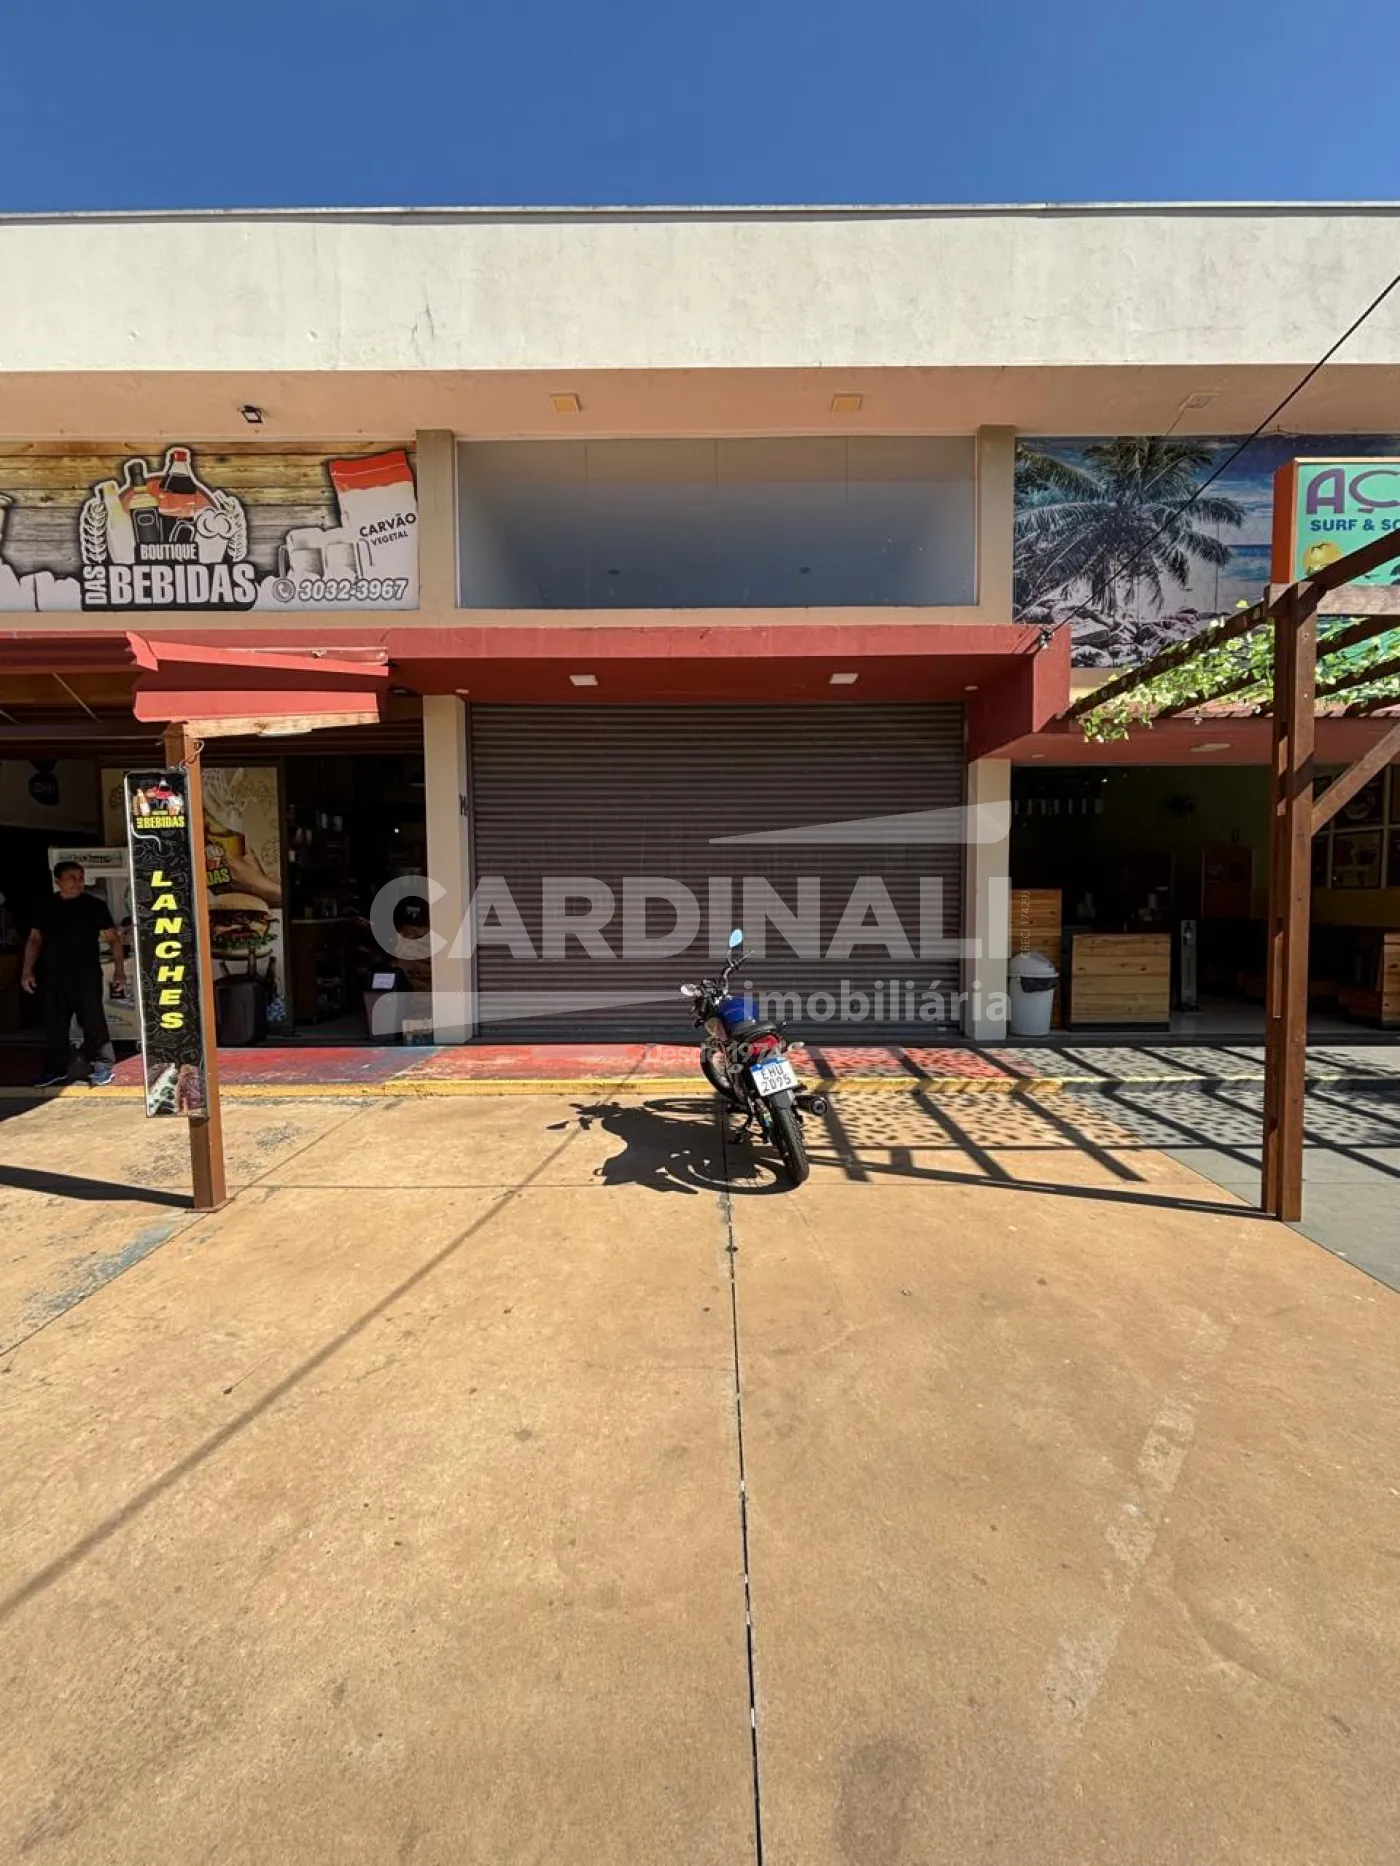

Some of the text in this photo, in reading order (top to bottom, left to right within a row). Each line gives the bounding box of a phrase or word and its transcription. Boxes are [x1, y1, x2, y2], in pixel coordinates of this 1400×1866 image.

[359, 513, 417, 537] CARVÃO
[1310, 518, 1358, 532] SURF
[1363, 518, 1375, 532] &
[370, 530, 409, 546] VEGETAL
[140, 543, 198, 561] BOUTIQUE
[83, 563, 256, 605] DAS BEBIDAS
[299, 578, 409, 601] 3032-3967
[143, 816, 185, 829] BEBIDAS
[151, 869, 185, 1029] LANCHES
